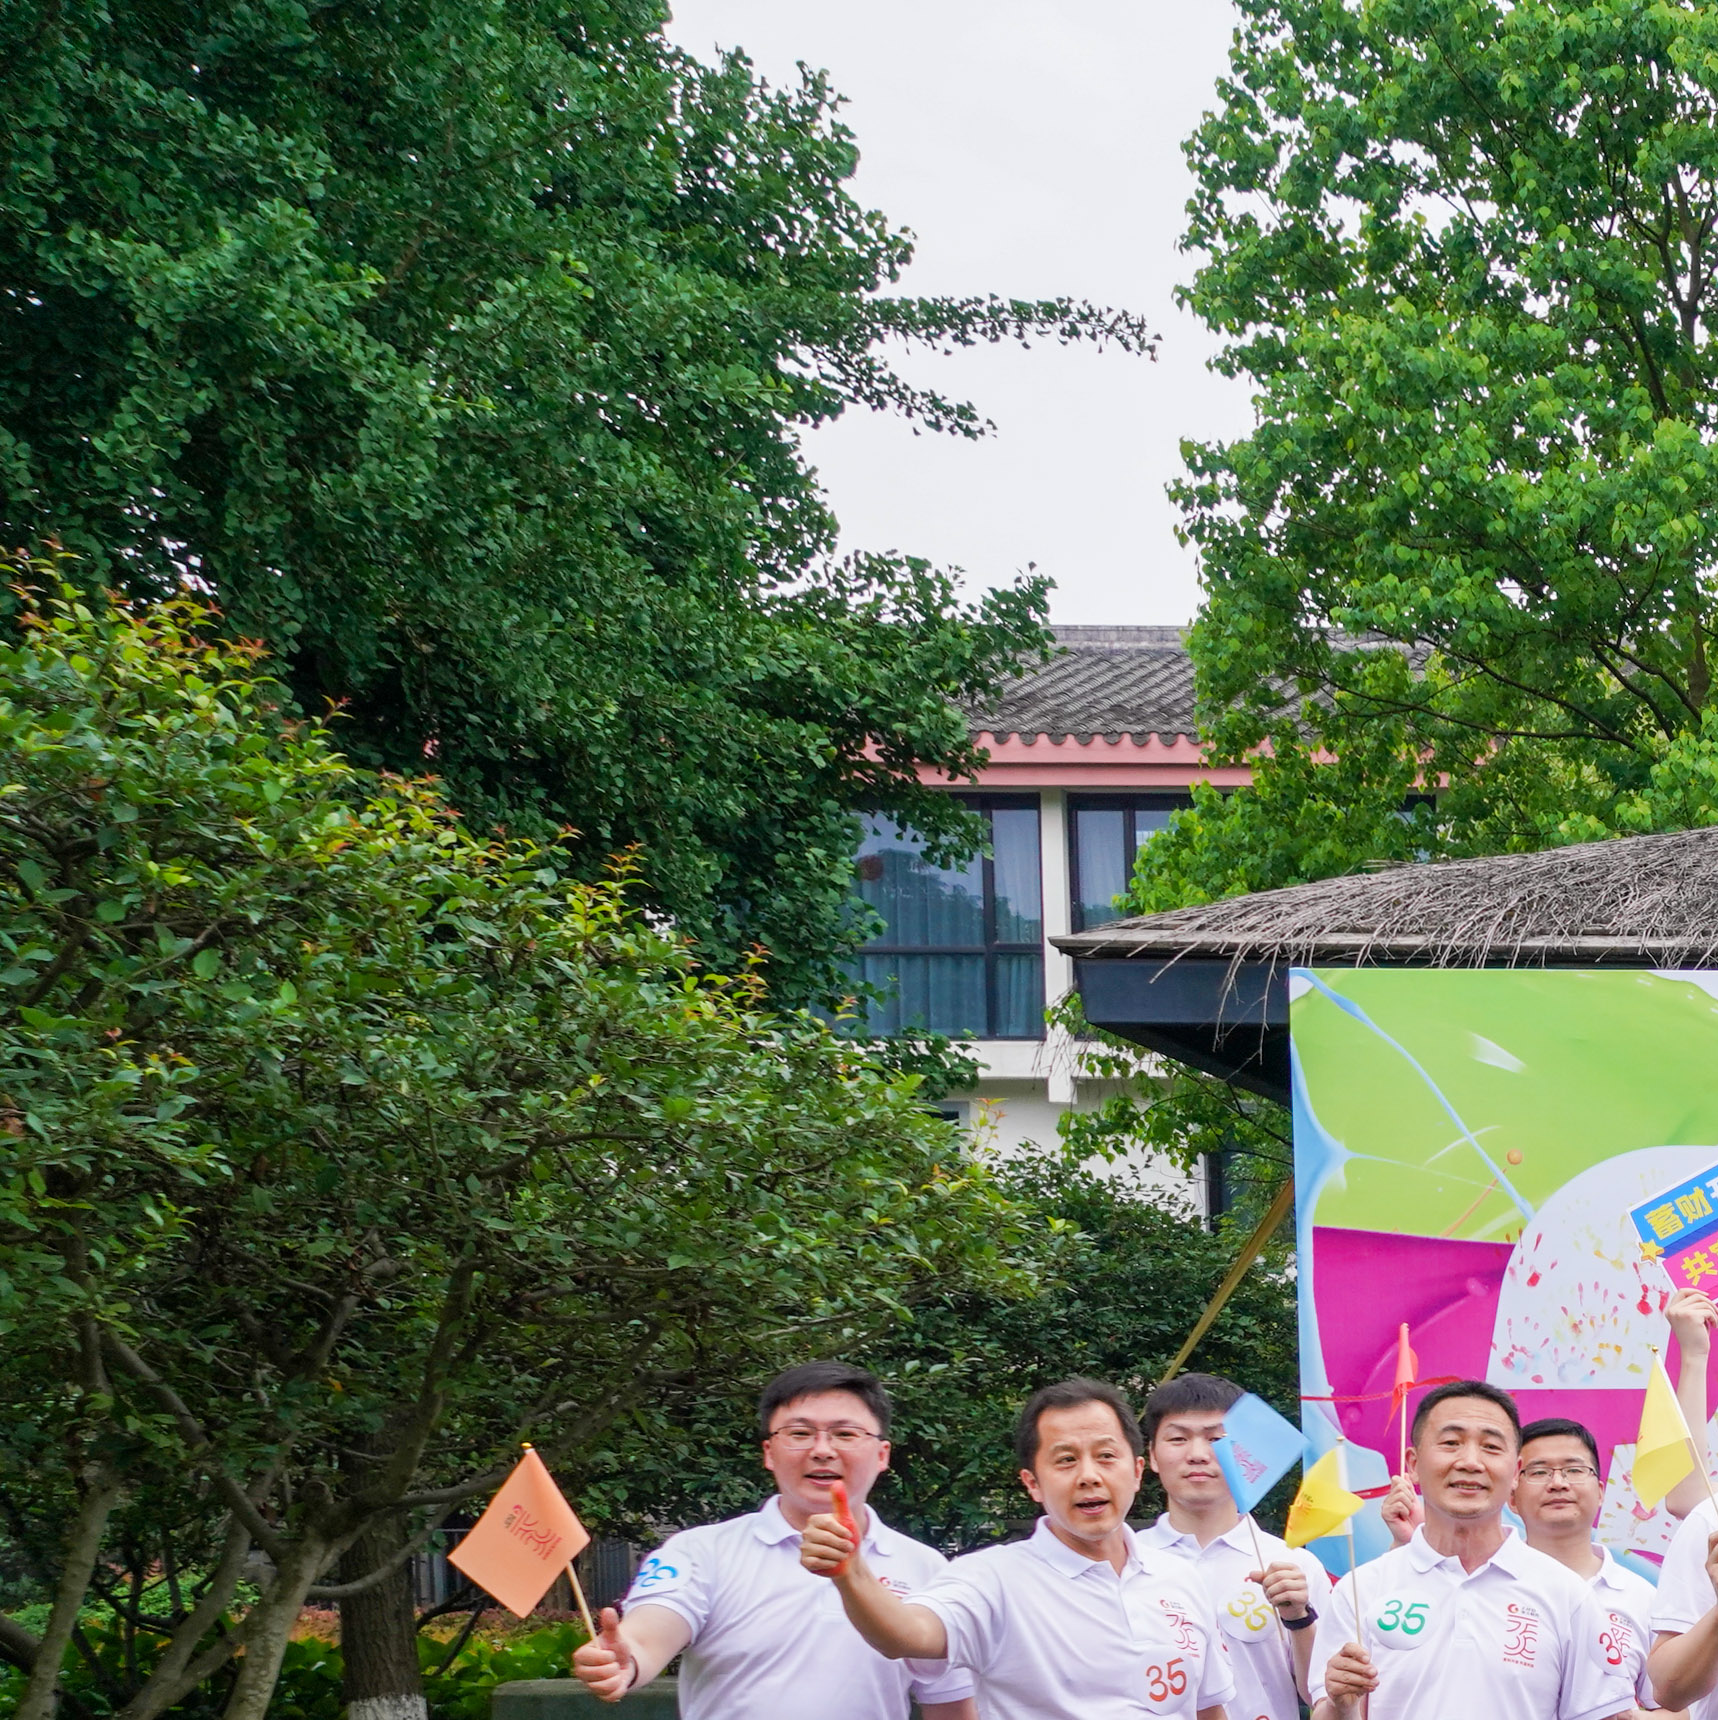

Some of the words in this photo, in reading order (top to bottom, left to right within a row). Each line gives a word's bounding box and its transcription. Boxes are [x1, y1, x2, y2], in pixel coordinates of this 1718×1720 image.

[1227, 1590, 1274, 1632] 35
[1376, 1599, 1430, 1636] 35
[1146, 1657, 1188, 1702] 35
